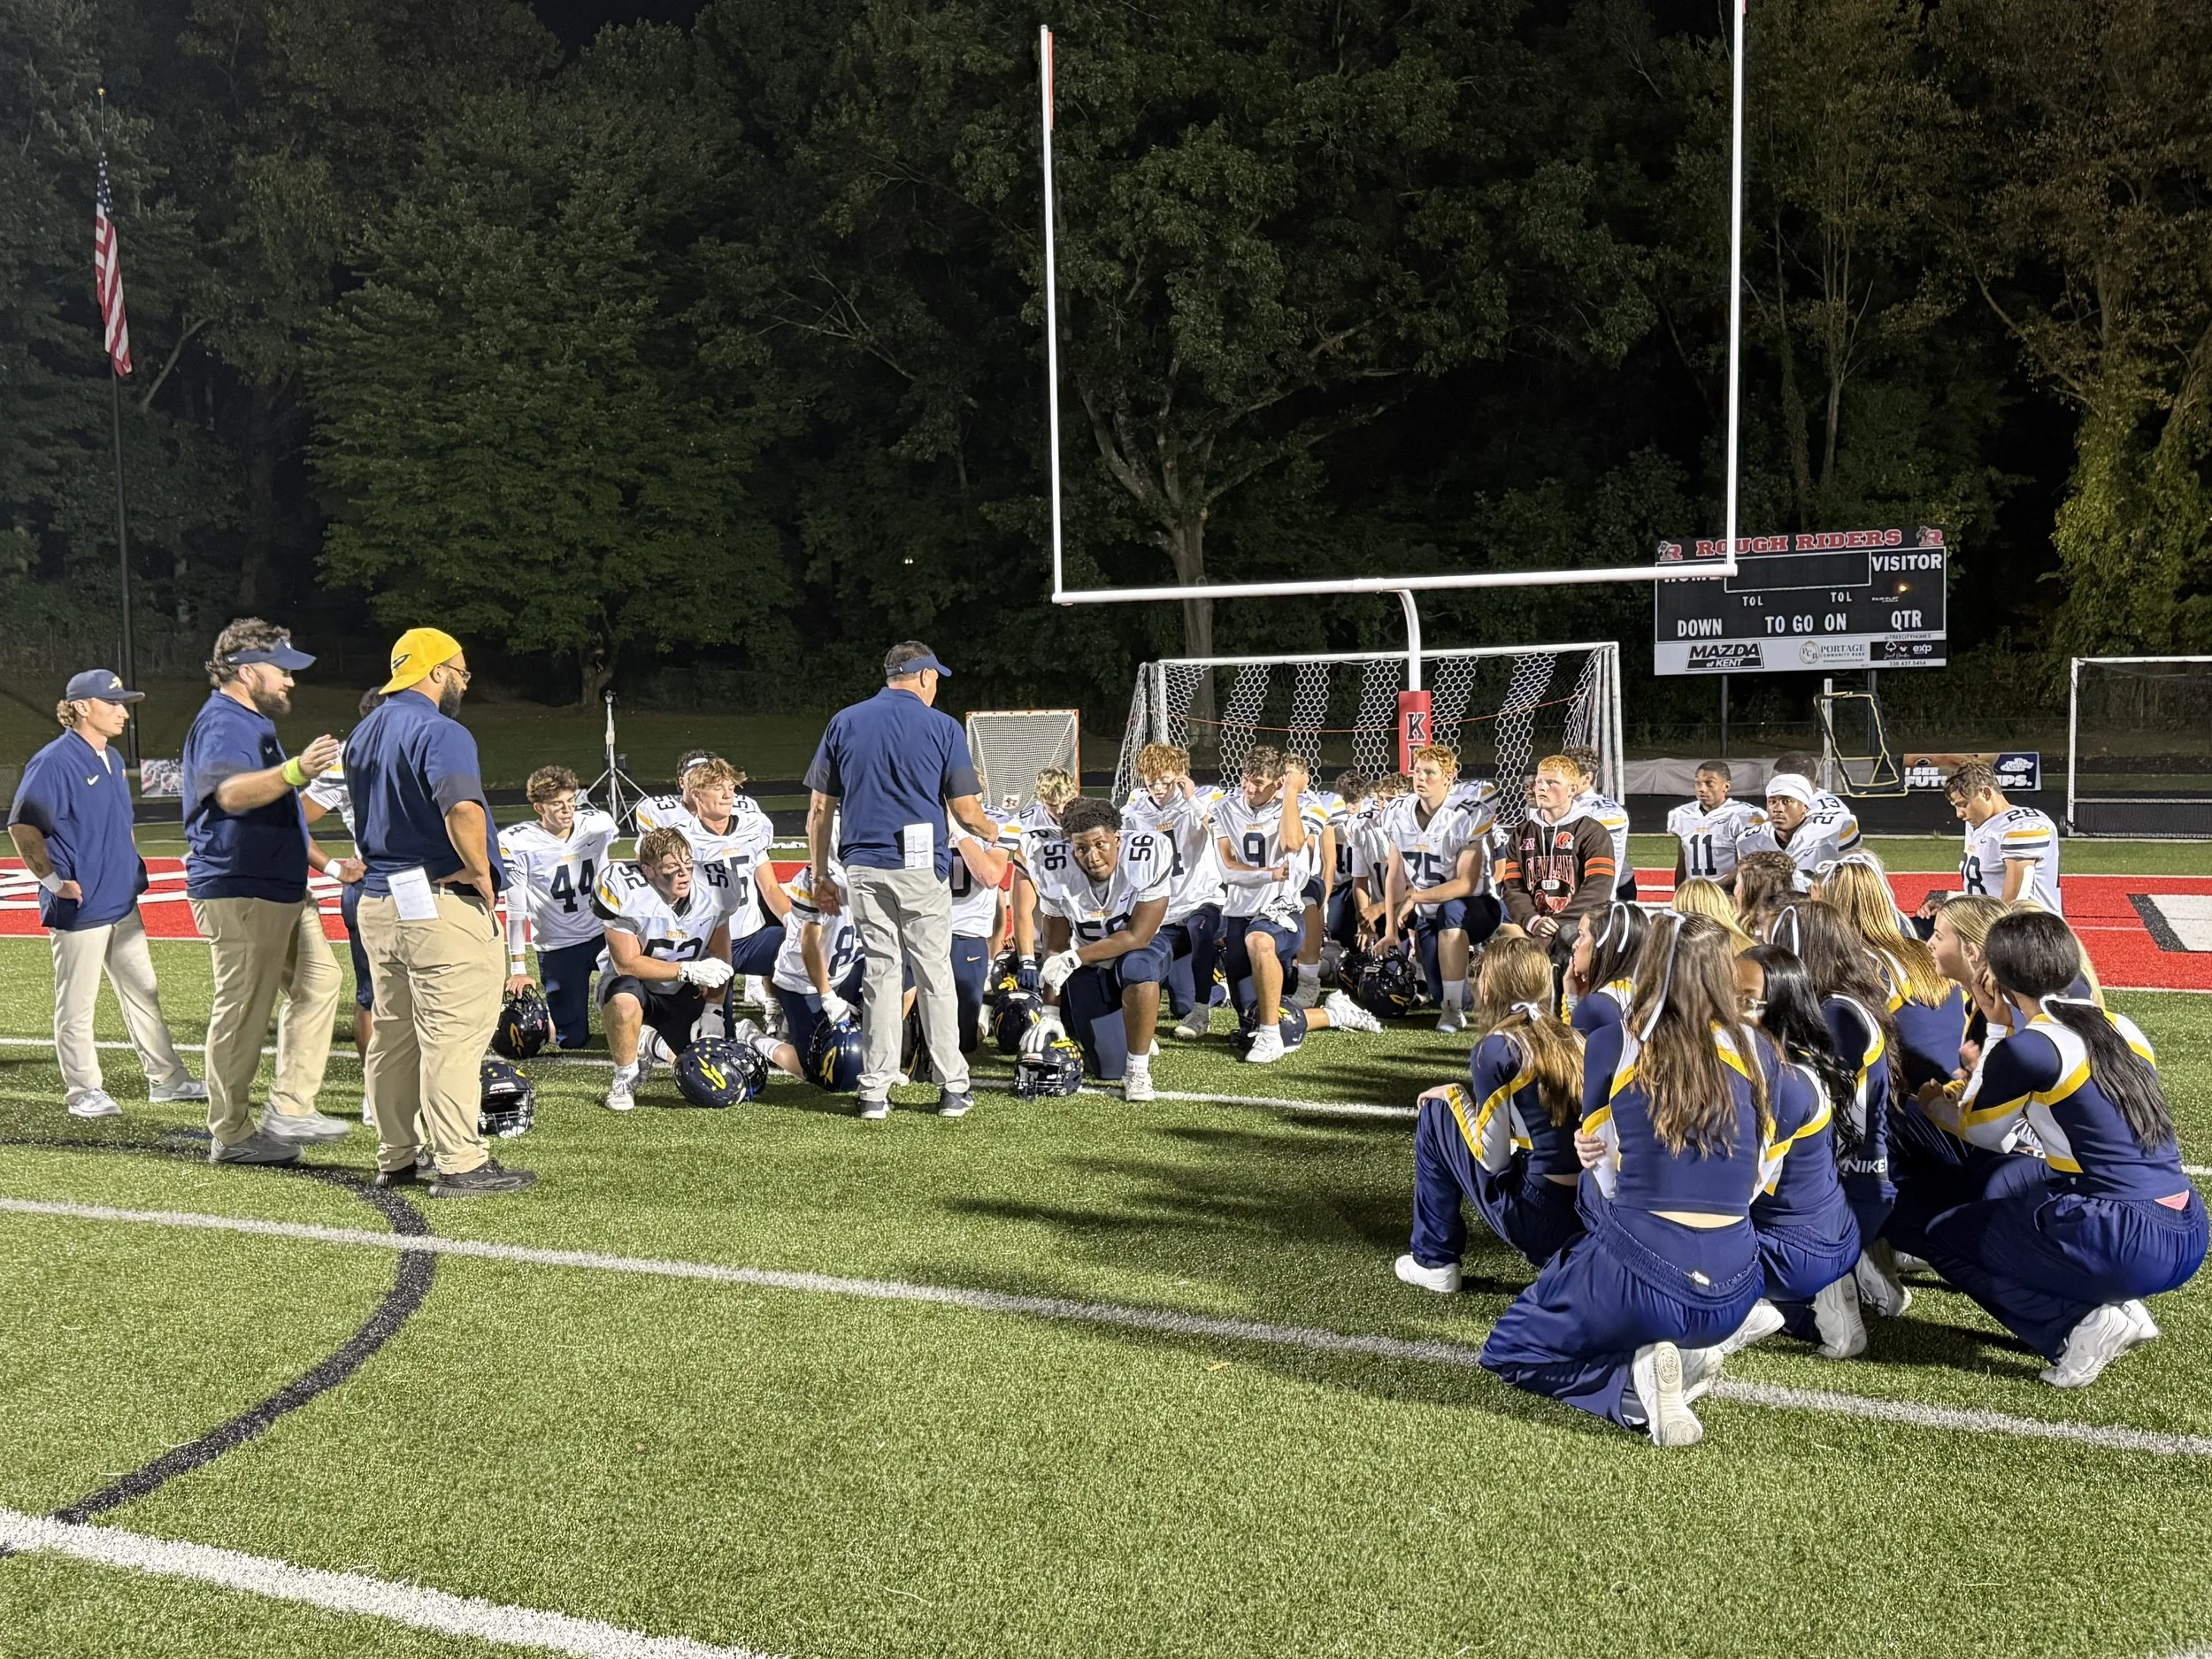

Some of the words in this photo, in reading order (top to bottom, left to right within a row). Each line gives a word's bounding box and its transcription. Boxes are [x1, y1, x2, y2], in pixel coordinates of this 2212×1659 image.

[1695, 535, 1788, 557] ROUGH
[1796, 529, 1902, 551] RIDERS
[1871, 554, 1942, 572] VISITOR
[1742, 595, 1763, 606] TOL
[1830, 591, 1852, 602] TOL
[1678, 618, 1723, 637] DOWN
[1765, 615, 1786, 634] TO
[1792, 615, 1814, 633] GO
[1824, 613, 1847, 631] ON
[1891, 610, 1922, 631] QTR
[1690, 643, 1760, 658] MAZDA
[1821, 644, 1865, 653] PORTAGE
[1913, 644, 1932, 654] exp
[1716, 658, 1743, 667] KENT
[1997, 775, 2032, 787] IPS.
[1817, 797, 1839, 810] 13
[2004, 808, 2040, 822] 28
[1043, 843, 1067, 871] 56
[1128, 835, 1155, 862] 56
[1243, 832, 1266, 868] 9
[1689, 834, 1717, 876] 11
[618, 864, 649, 890] 52
[703, 862, 729, 889] 52
[1402, 851, 1447, 888] 75
[550, 858, 595, 913] 44
[1842, 1158, 1886, 1173] NIKE
